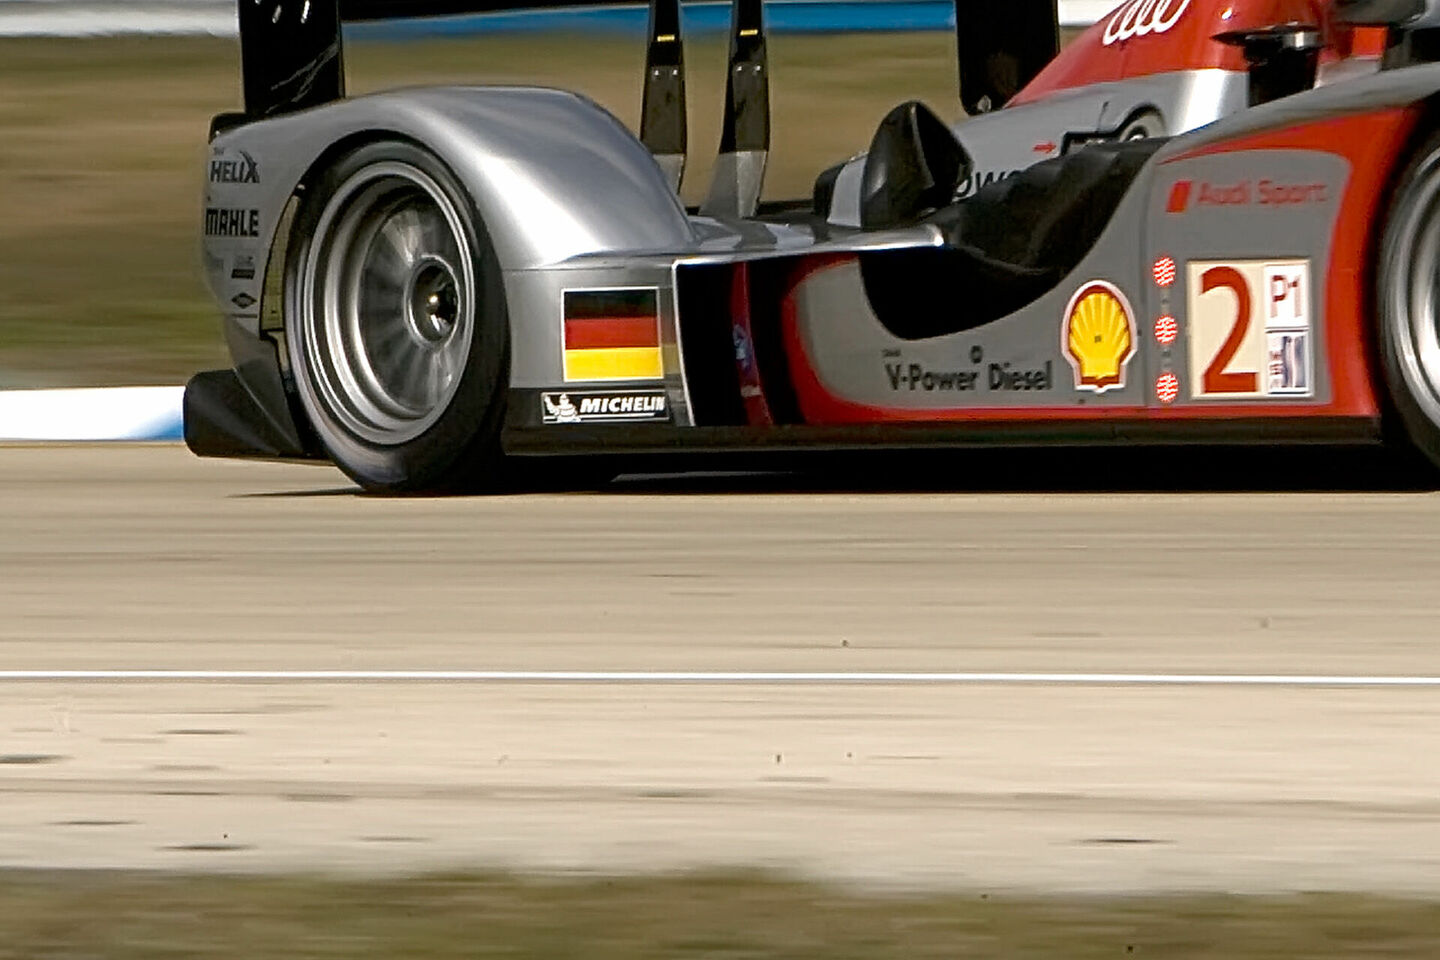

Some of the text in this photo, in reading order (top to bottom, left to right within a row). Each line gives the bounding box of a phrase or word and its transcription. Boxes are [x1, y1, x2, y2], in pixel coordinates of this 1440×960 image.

[210, 150, 260, 183] HELIX
[1197, 179, 1328, 208] Audi Sport
[205, 207, 259, 236] MAHLE
[1269, 273, 1304, 319] P1
[1199, 265, 1260, 394] 2
[884, 359, 1053, 391] V-Power Diesel
[579, 396, 666, 414] MICHELIN
